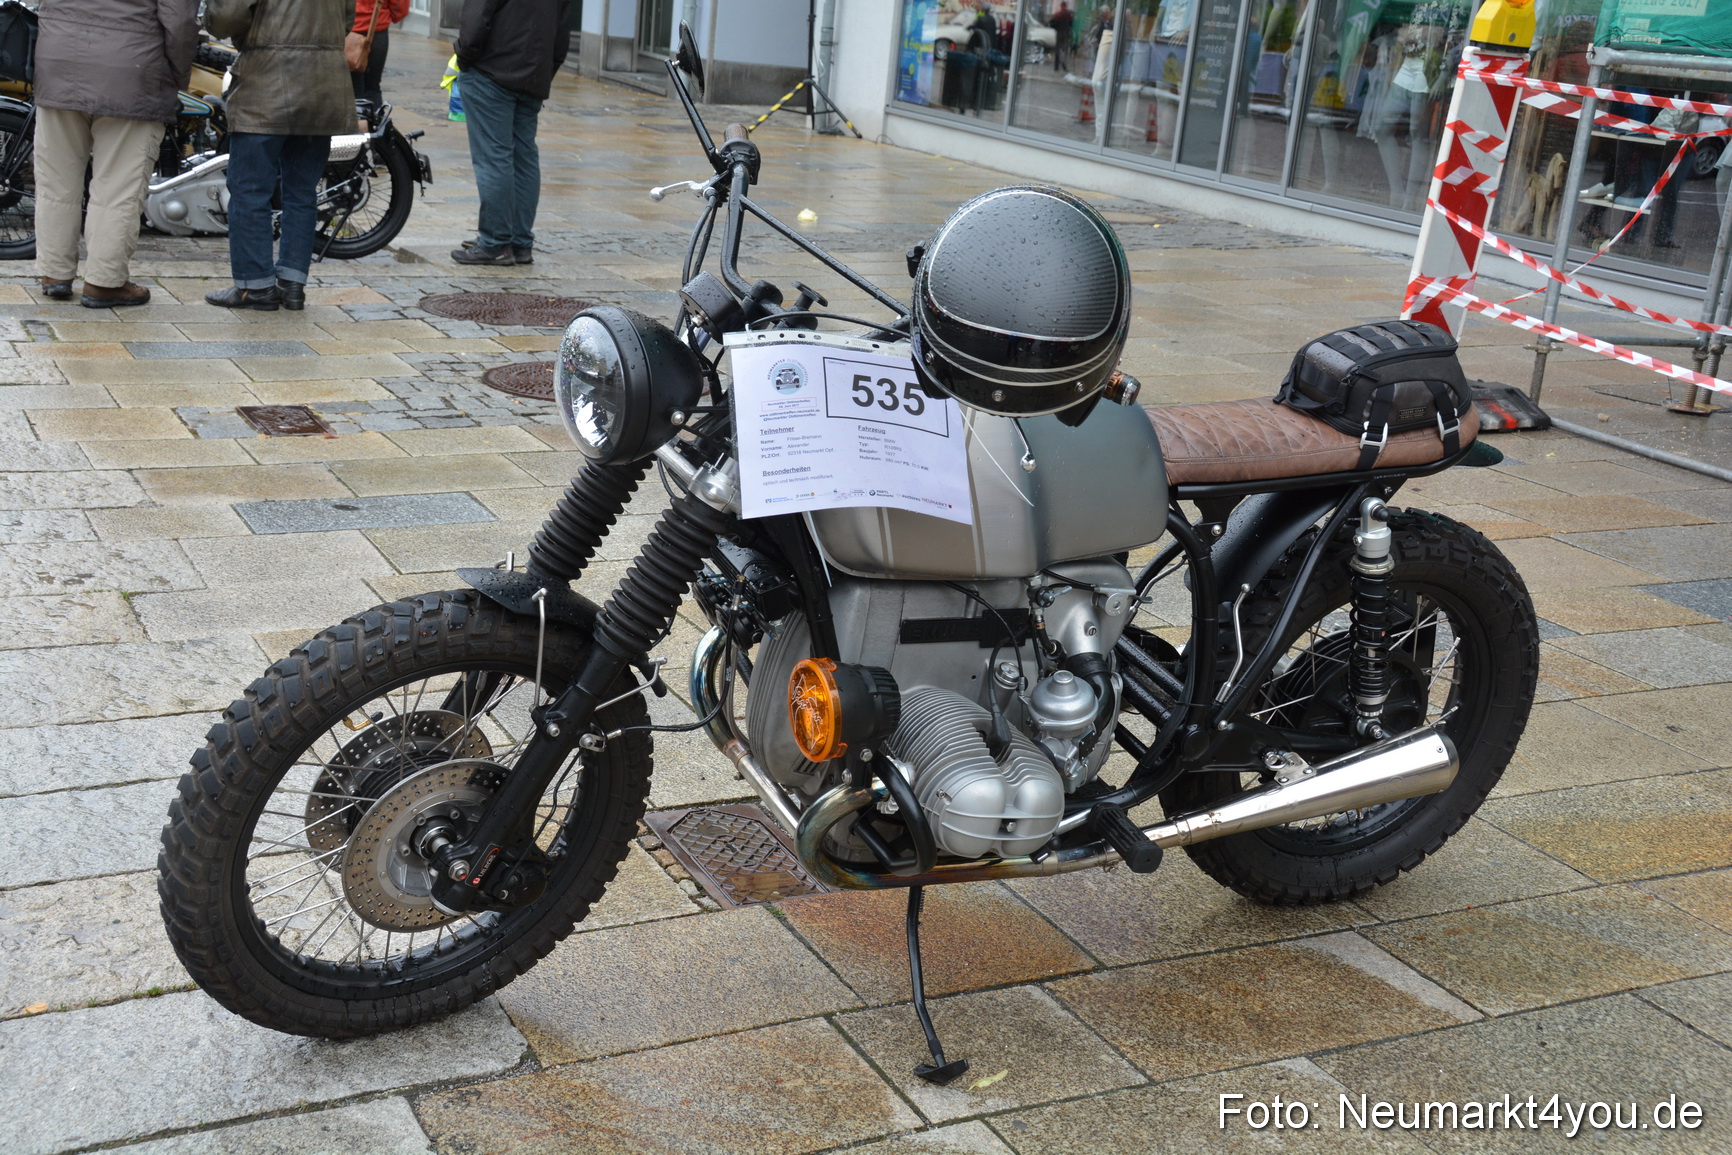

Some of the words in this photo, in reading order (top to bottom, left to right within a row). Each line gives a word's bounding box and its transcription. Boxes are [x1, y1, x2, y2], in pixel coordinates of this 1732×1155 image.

[1213, 4, 1230, 15] mavi
[851, 374, 925, 416] 535
[760, 426, 795, 435] Teilnehmer
[858, 425, 886, 435] Fahrzeug
[762, 466, 811, 477] Besonderheiten
